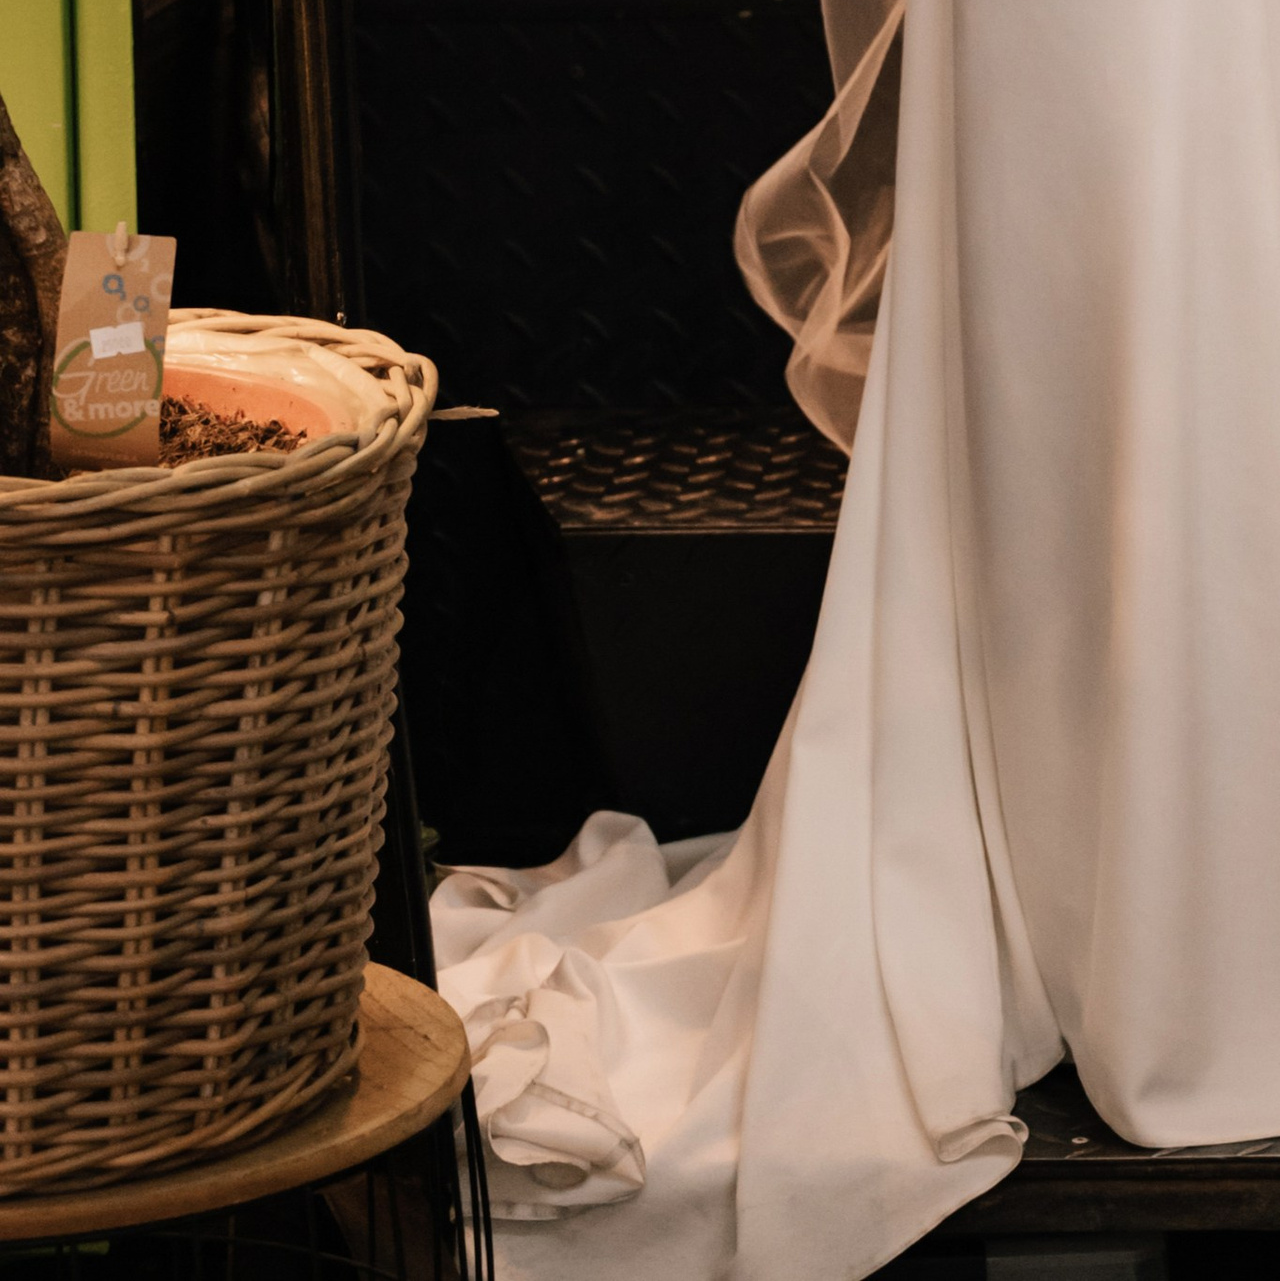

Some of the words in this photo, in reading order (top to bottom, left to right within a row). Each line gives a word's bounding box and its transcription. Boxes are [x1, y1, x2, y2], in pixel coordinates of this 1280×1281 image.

[52, 339, 149, 405] Green
[63, 399, 85, 422] &
[88, 400, 160, 420] more
